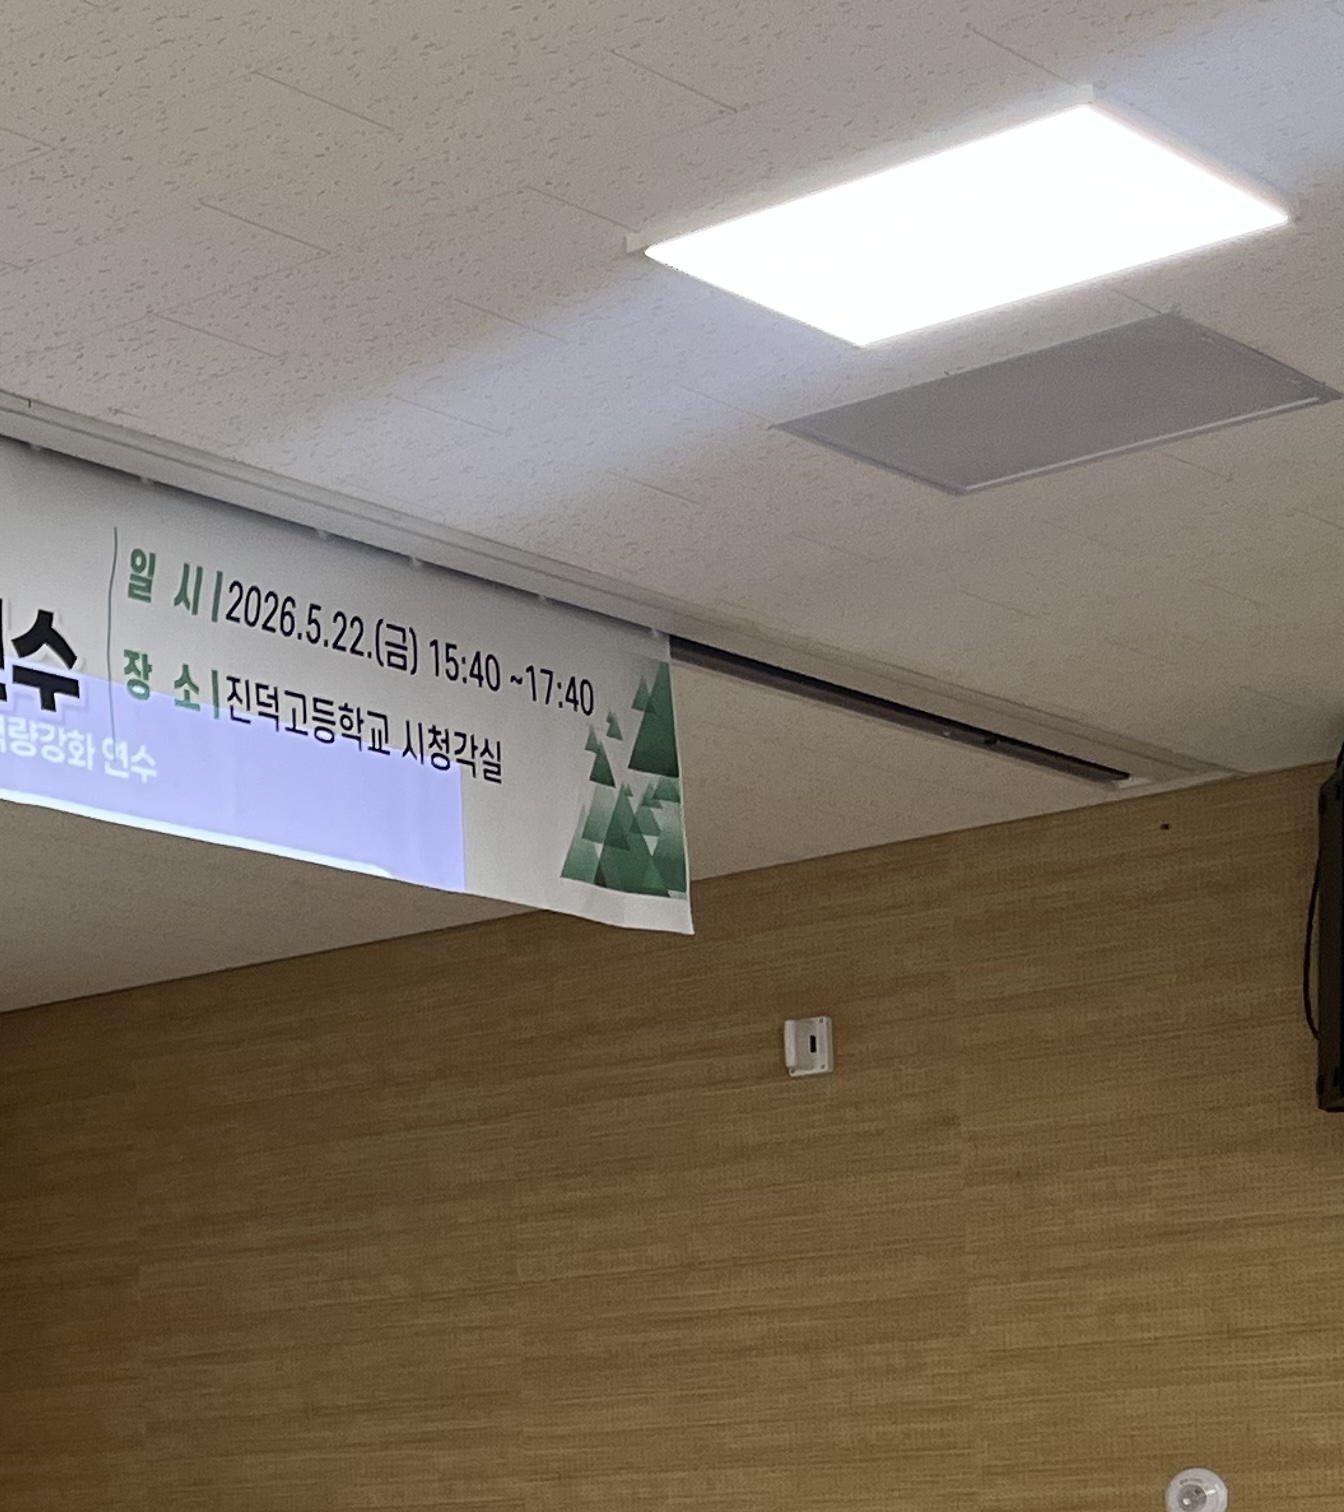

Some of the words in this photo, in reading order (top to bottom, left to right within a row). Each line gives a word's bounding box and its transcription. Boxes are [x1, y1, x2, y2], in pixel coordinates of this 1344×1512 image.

[127, 548, 156, 602] 일
[226, 580, 418, 675] 2026.5.22.(금)
[430, 638, 500, 692] 15:40
[510, 665, 594, 716] ~17:40
[104, 742, 158, 783] 연수
[123, 648, 152, 700] 장
[227, 675, 391, 756] 진덕고등학교
[402, 720, 502, 784] 시청각실
